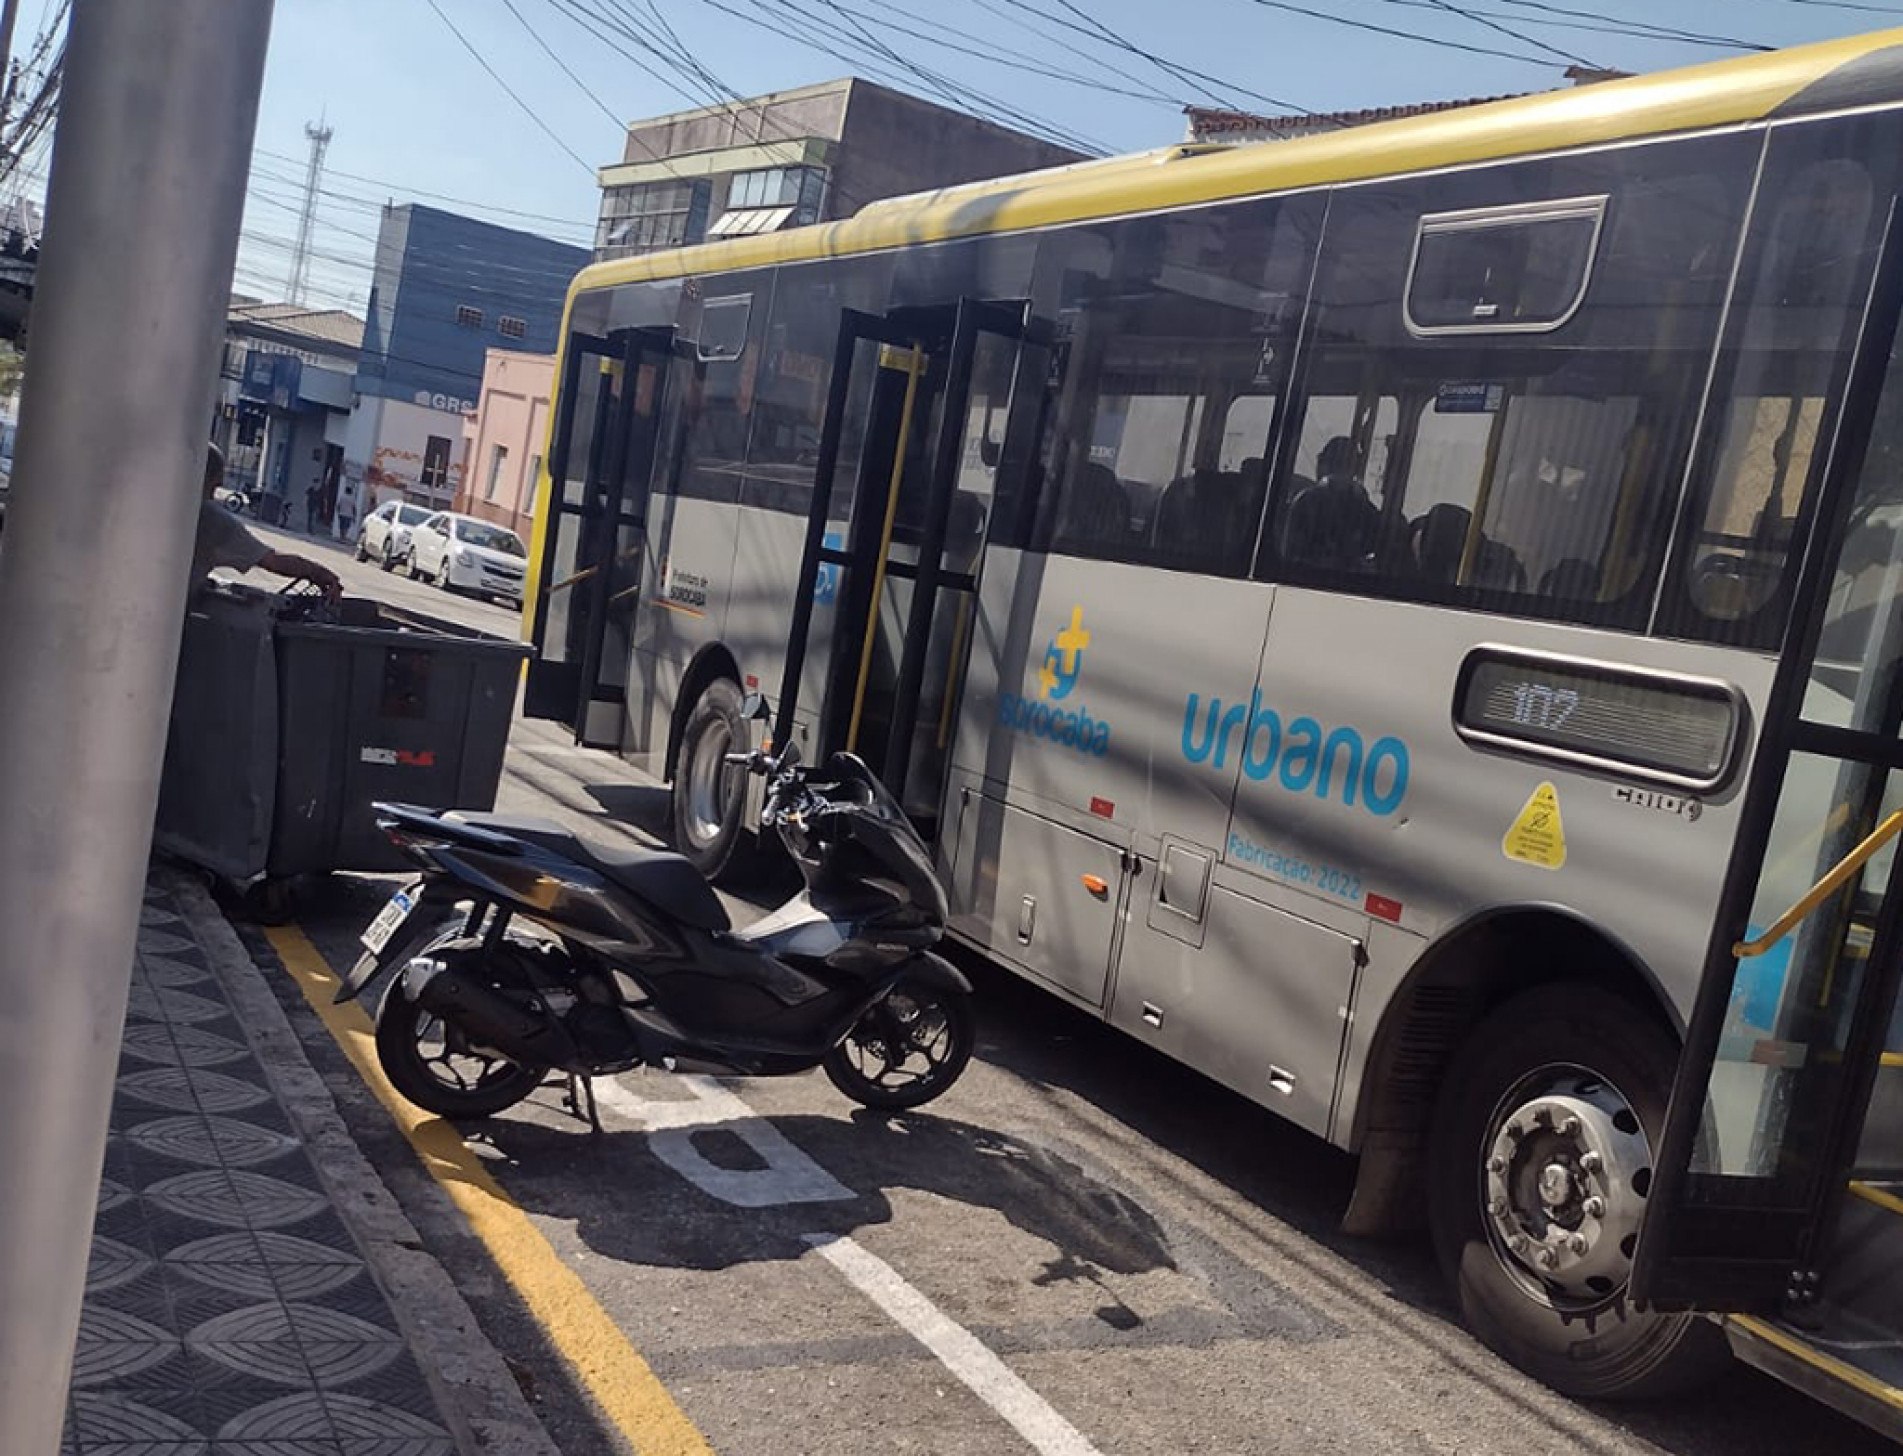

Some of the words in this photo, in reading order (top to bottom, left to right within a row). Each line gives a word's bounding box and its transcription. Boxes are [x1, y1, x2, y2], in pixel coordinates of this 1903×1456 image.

[1514, 682, 1578, 730] 107
[1180, 684, 1411, 816] urbano
[1316, 864, 1362, 901] 2022
